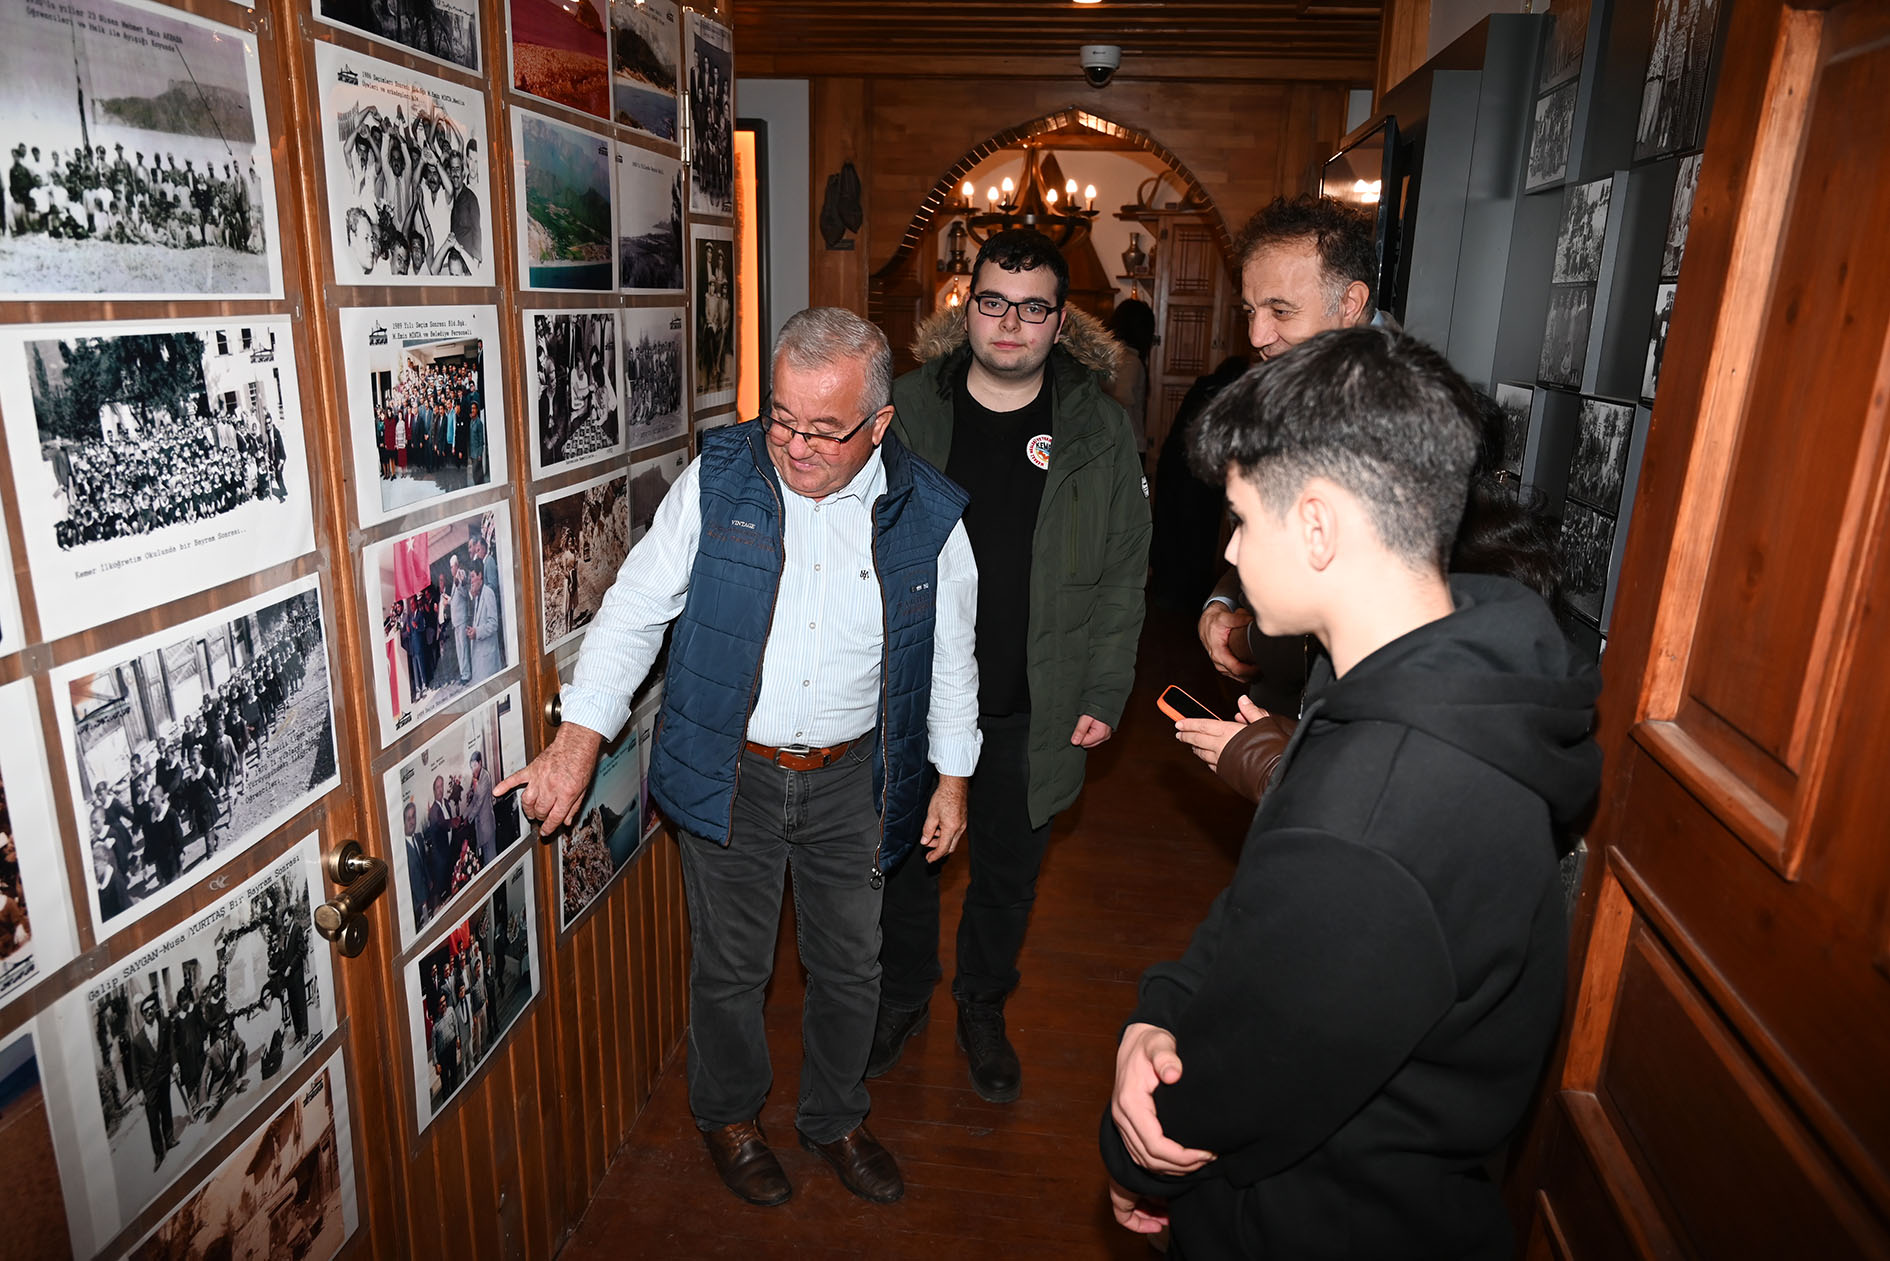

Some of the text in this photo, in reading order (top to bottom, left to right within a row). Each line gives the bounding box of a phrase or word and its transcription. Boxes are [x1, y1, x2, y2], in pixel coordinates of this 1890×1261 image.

[731, 519, 756, 529] VINTAGE
[88, 978, 119, 1001] Galip
[229, 896, 244, 911] Bir
[246, 876, 273, 898] Bayram
